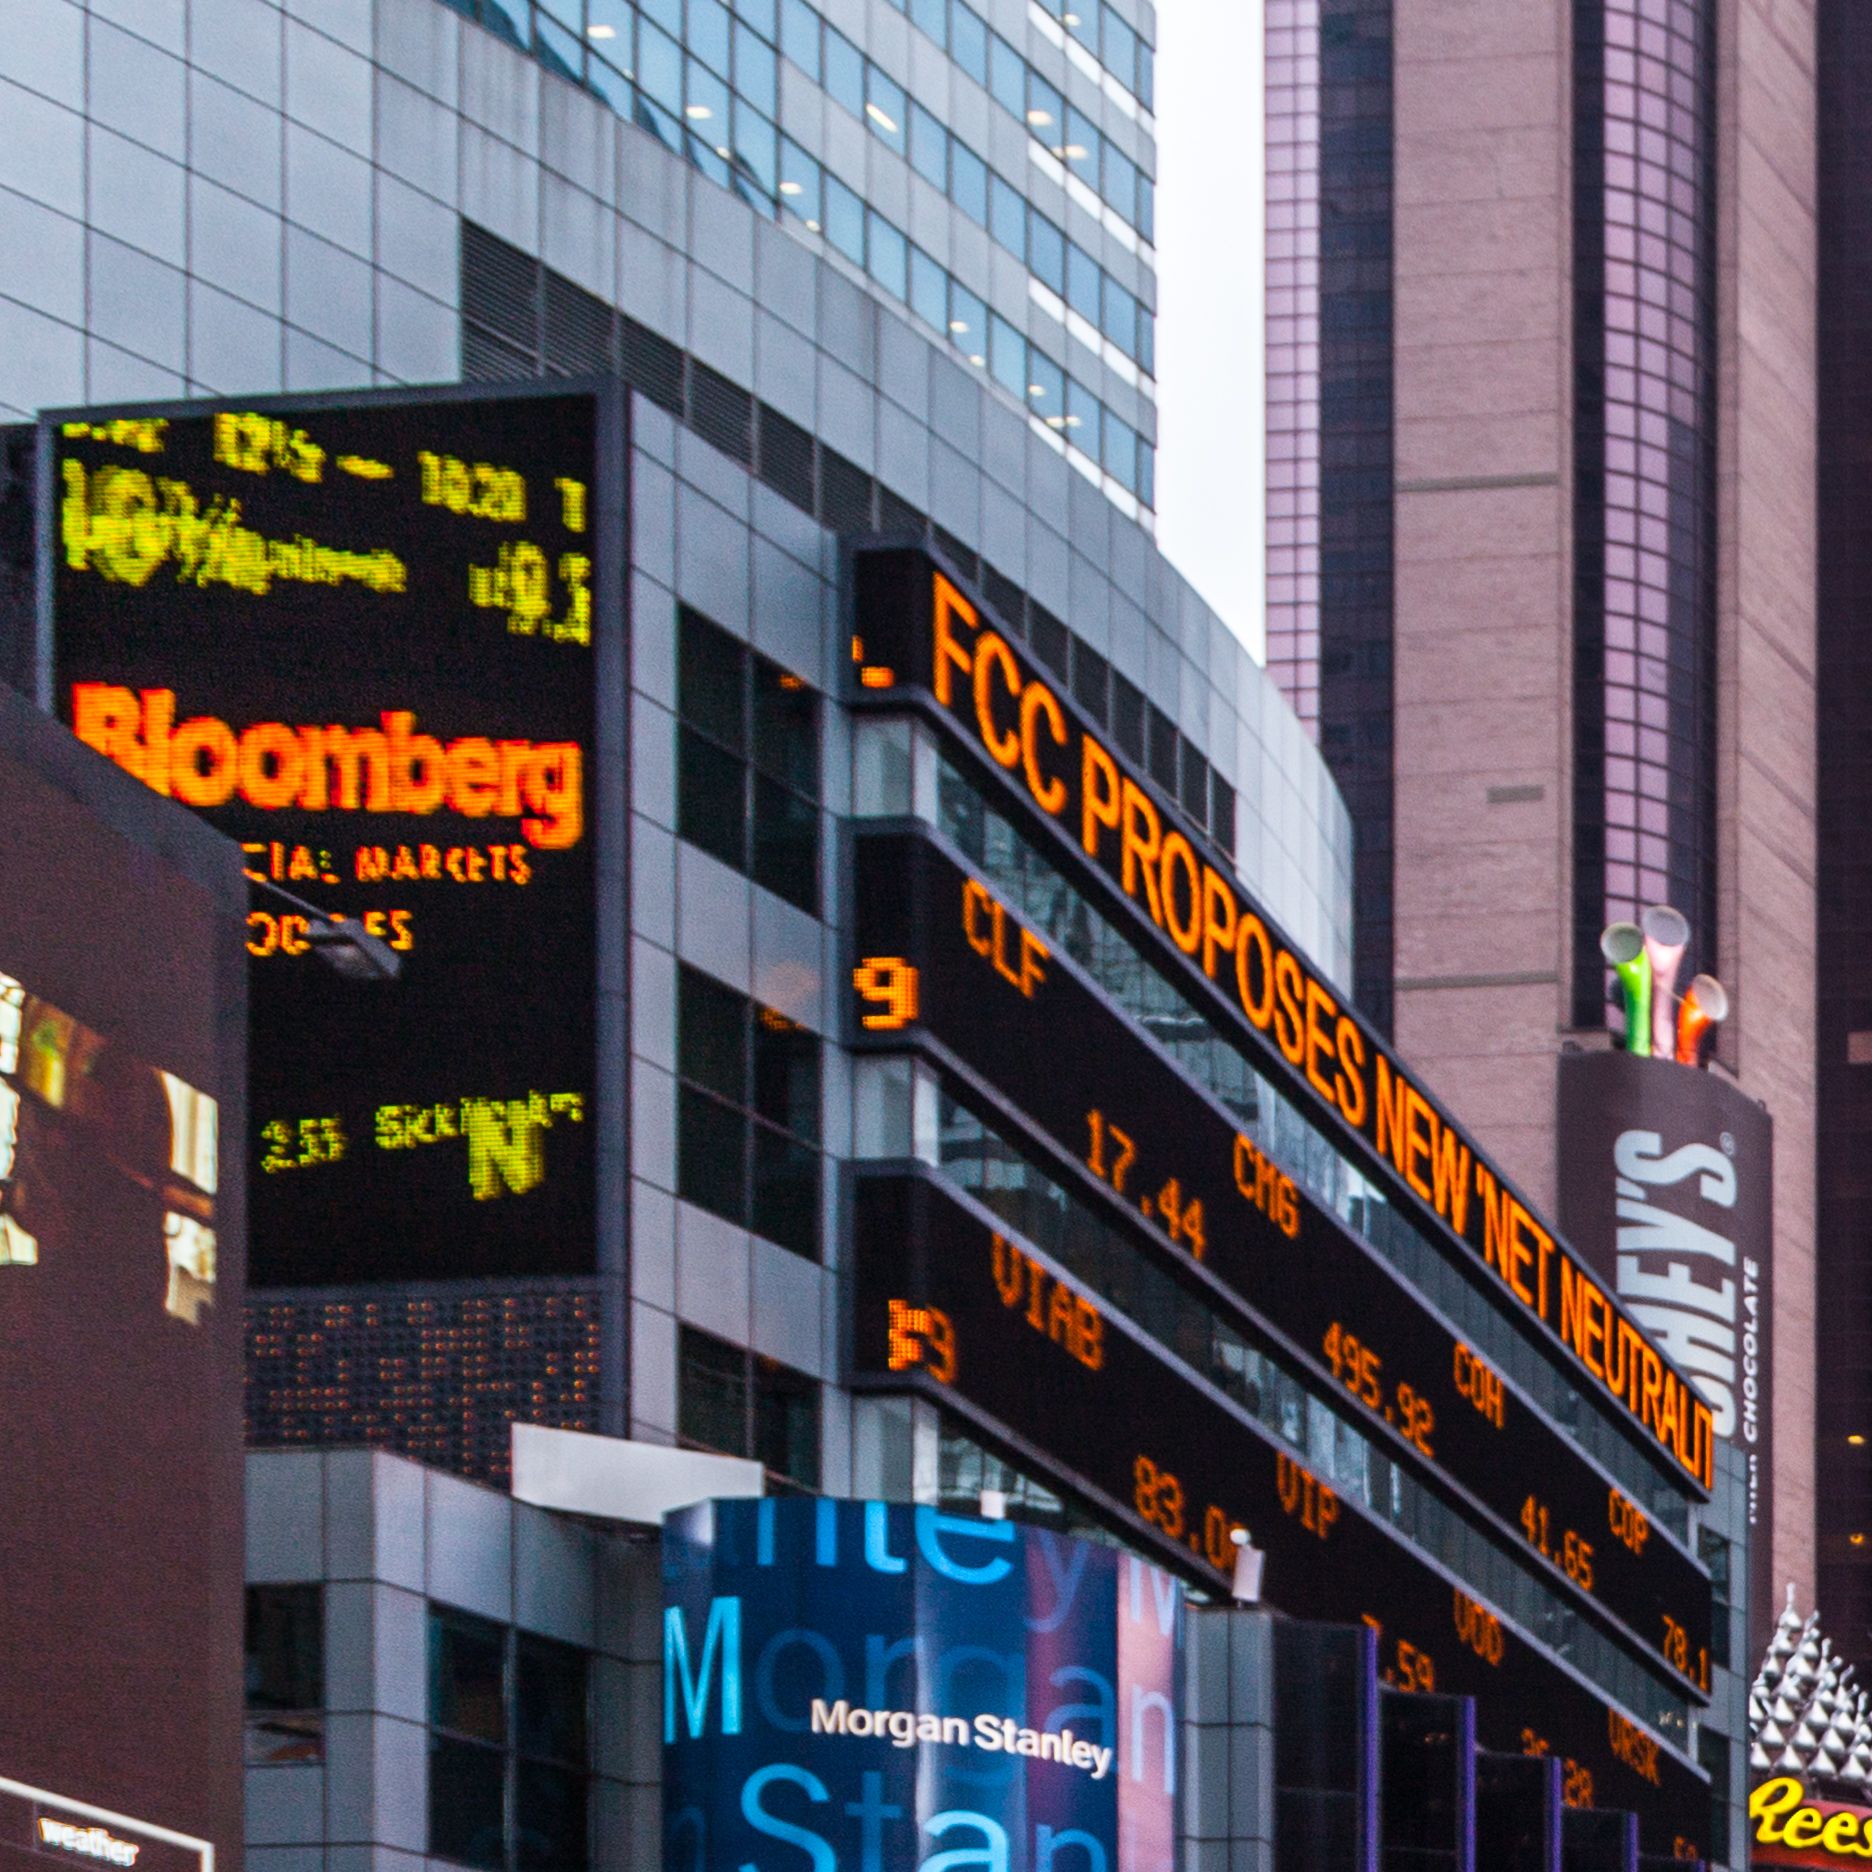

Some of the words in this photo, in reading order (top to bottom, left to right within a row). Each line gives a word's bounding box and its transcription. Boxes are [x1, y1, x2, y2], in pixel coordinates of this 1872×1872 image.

[72, 682, 584, 851] Bloomberg
[932, 570, 1069, 817] FCC
[1080, 730, 1368, 1129] PROPOSES
[1374, 1051, 1471, 1237] NEW
[961, 876, 1053, 999] CLF
[1233, 1130, 1300, 1240] CMG
[1083, 1109, 1206, 1261] 17.44
[1742, 1254, 1760, 1445] CHOCOLATE
[810, 1697, 967, 1750] Morgan
[973, 1712, 1113, 1780] Stanley
[37, 1816, 140, 1868] weather
